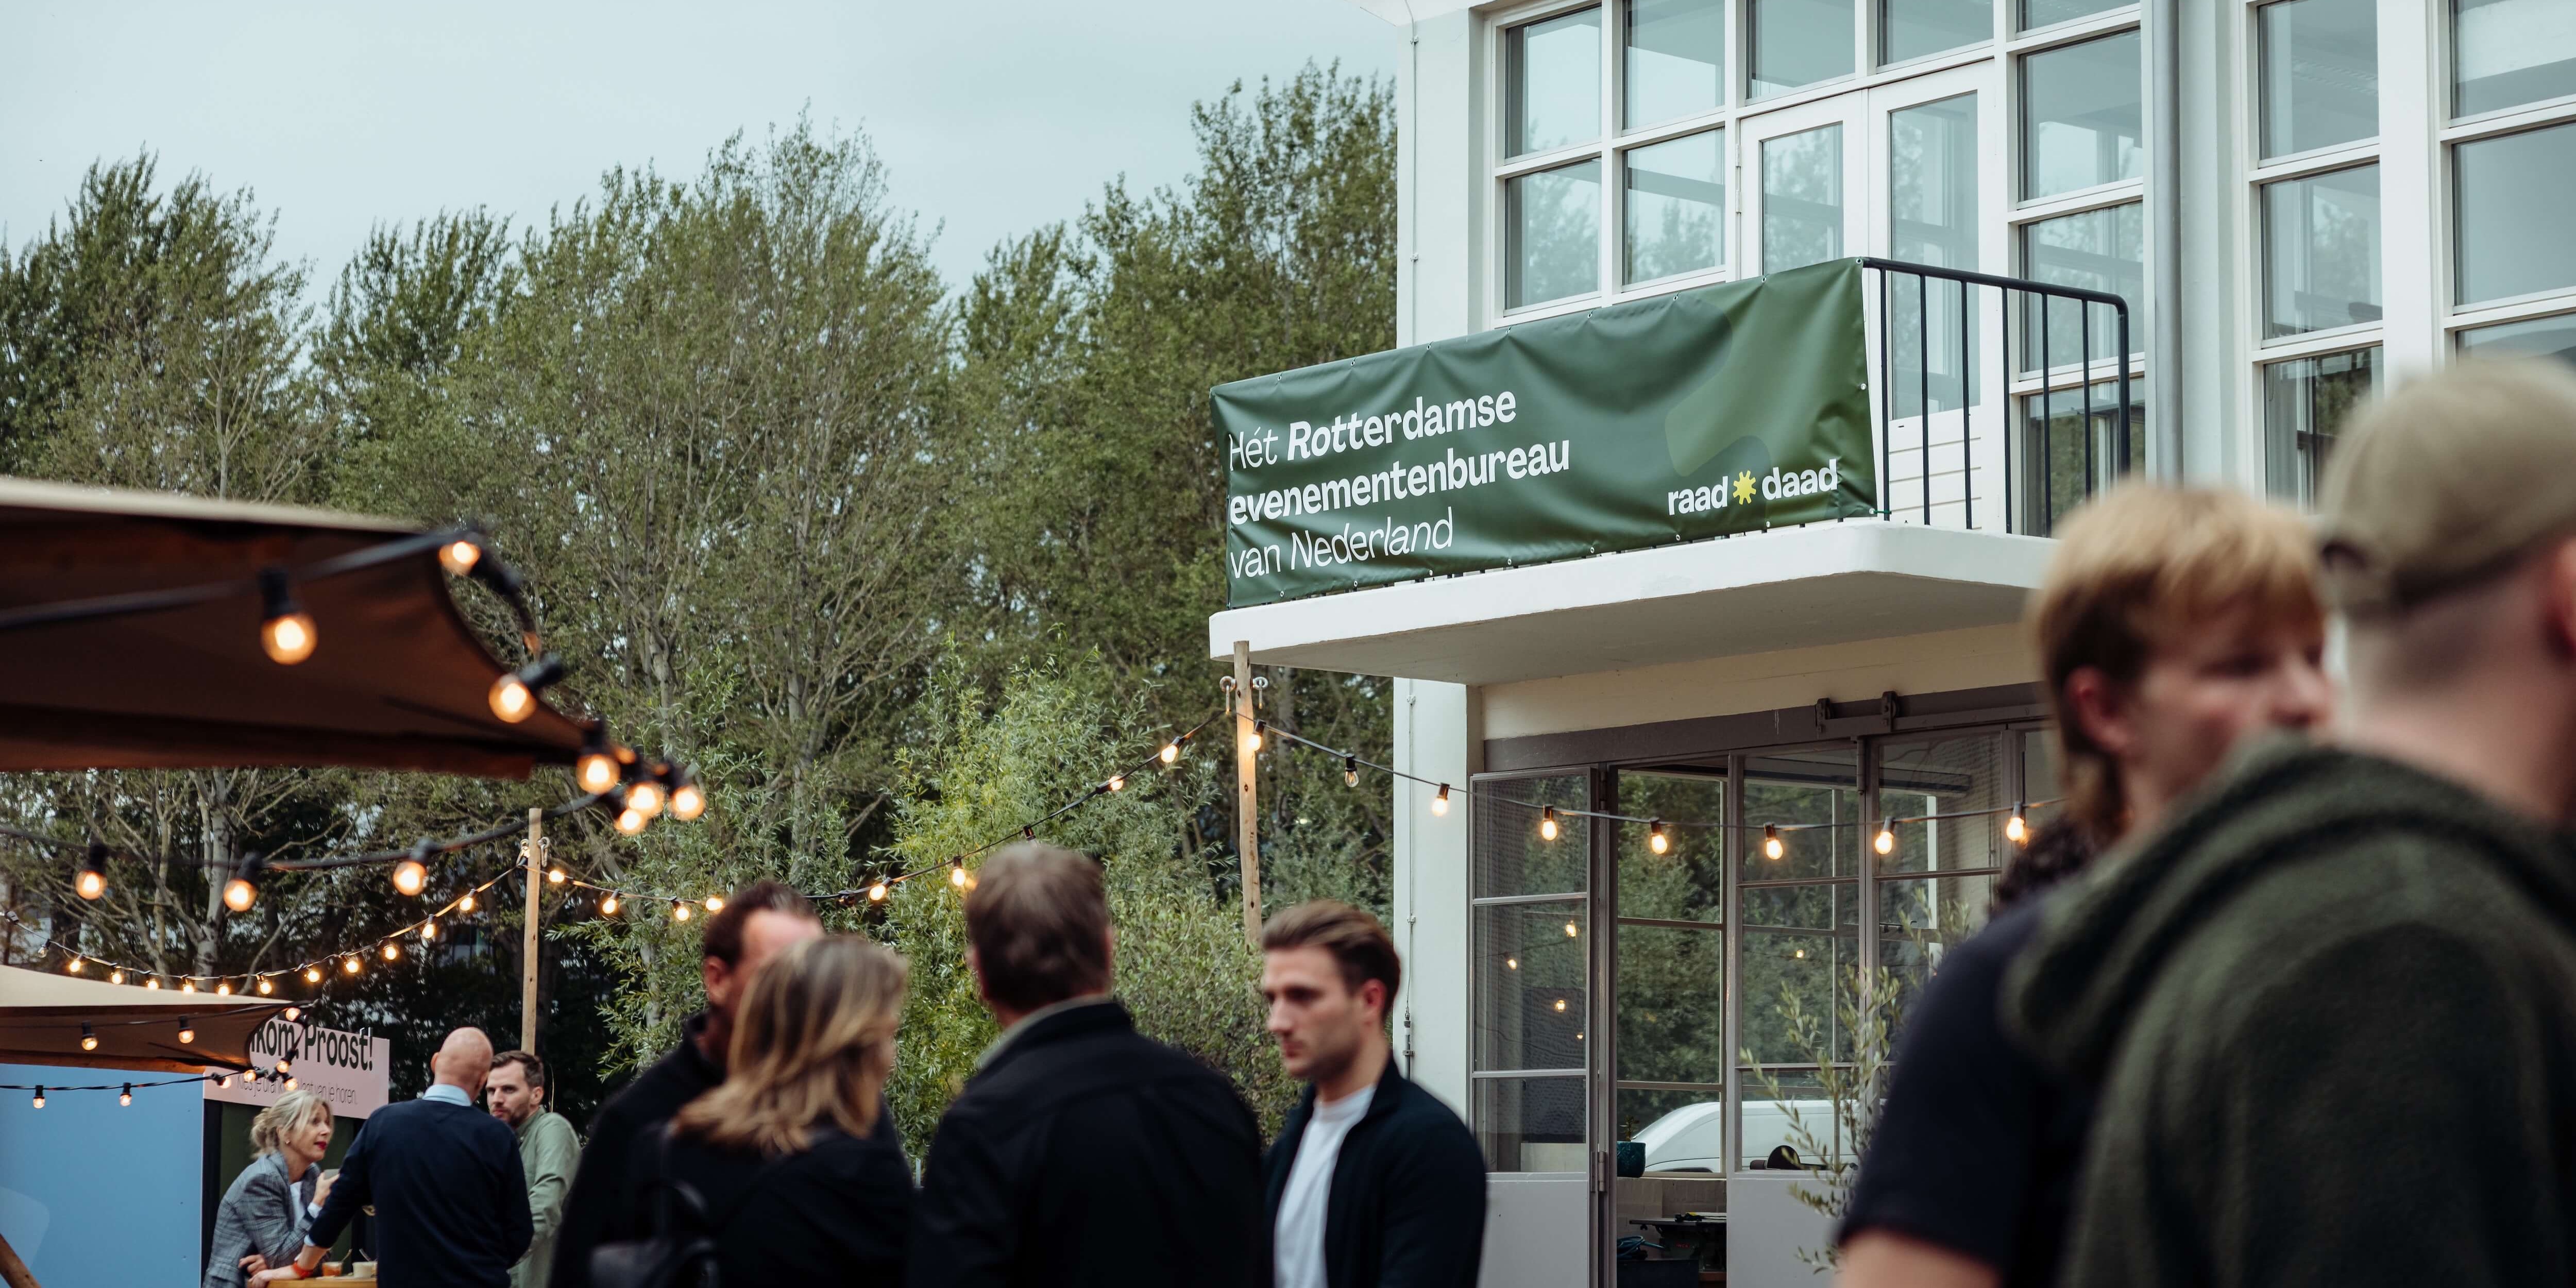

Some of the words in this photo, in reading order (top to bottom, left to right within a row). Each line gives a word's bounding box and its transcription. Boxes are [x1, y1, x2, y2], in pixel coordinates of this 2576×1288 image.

[1228, 427, 1279, 471] Hét
[1288, 391, 1516, 461] Rotterdamse
[1230, 439, 1570, 525] evenementenbureau
[1668, 476, 1728, 515] raad
[1762, 459, 1838, 500] daad
[1230, 544, 1281, 579] van
[1291, 506, 1453, 569] Nederland
[304, 1018, 373, 1071] Proost!
